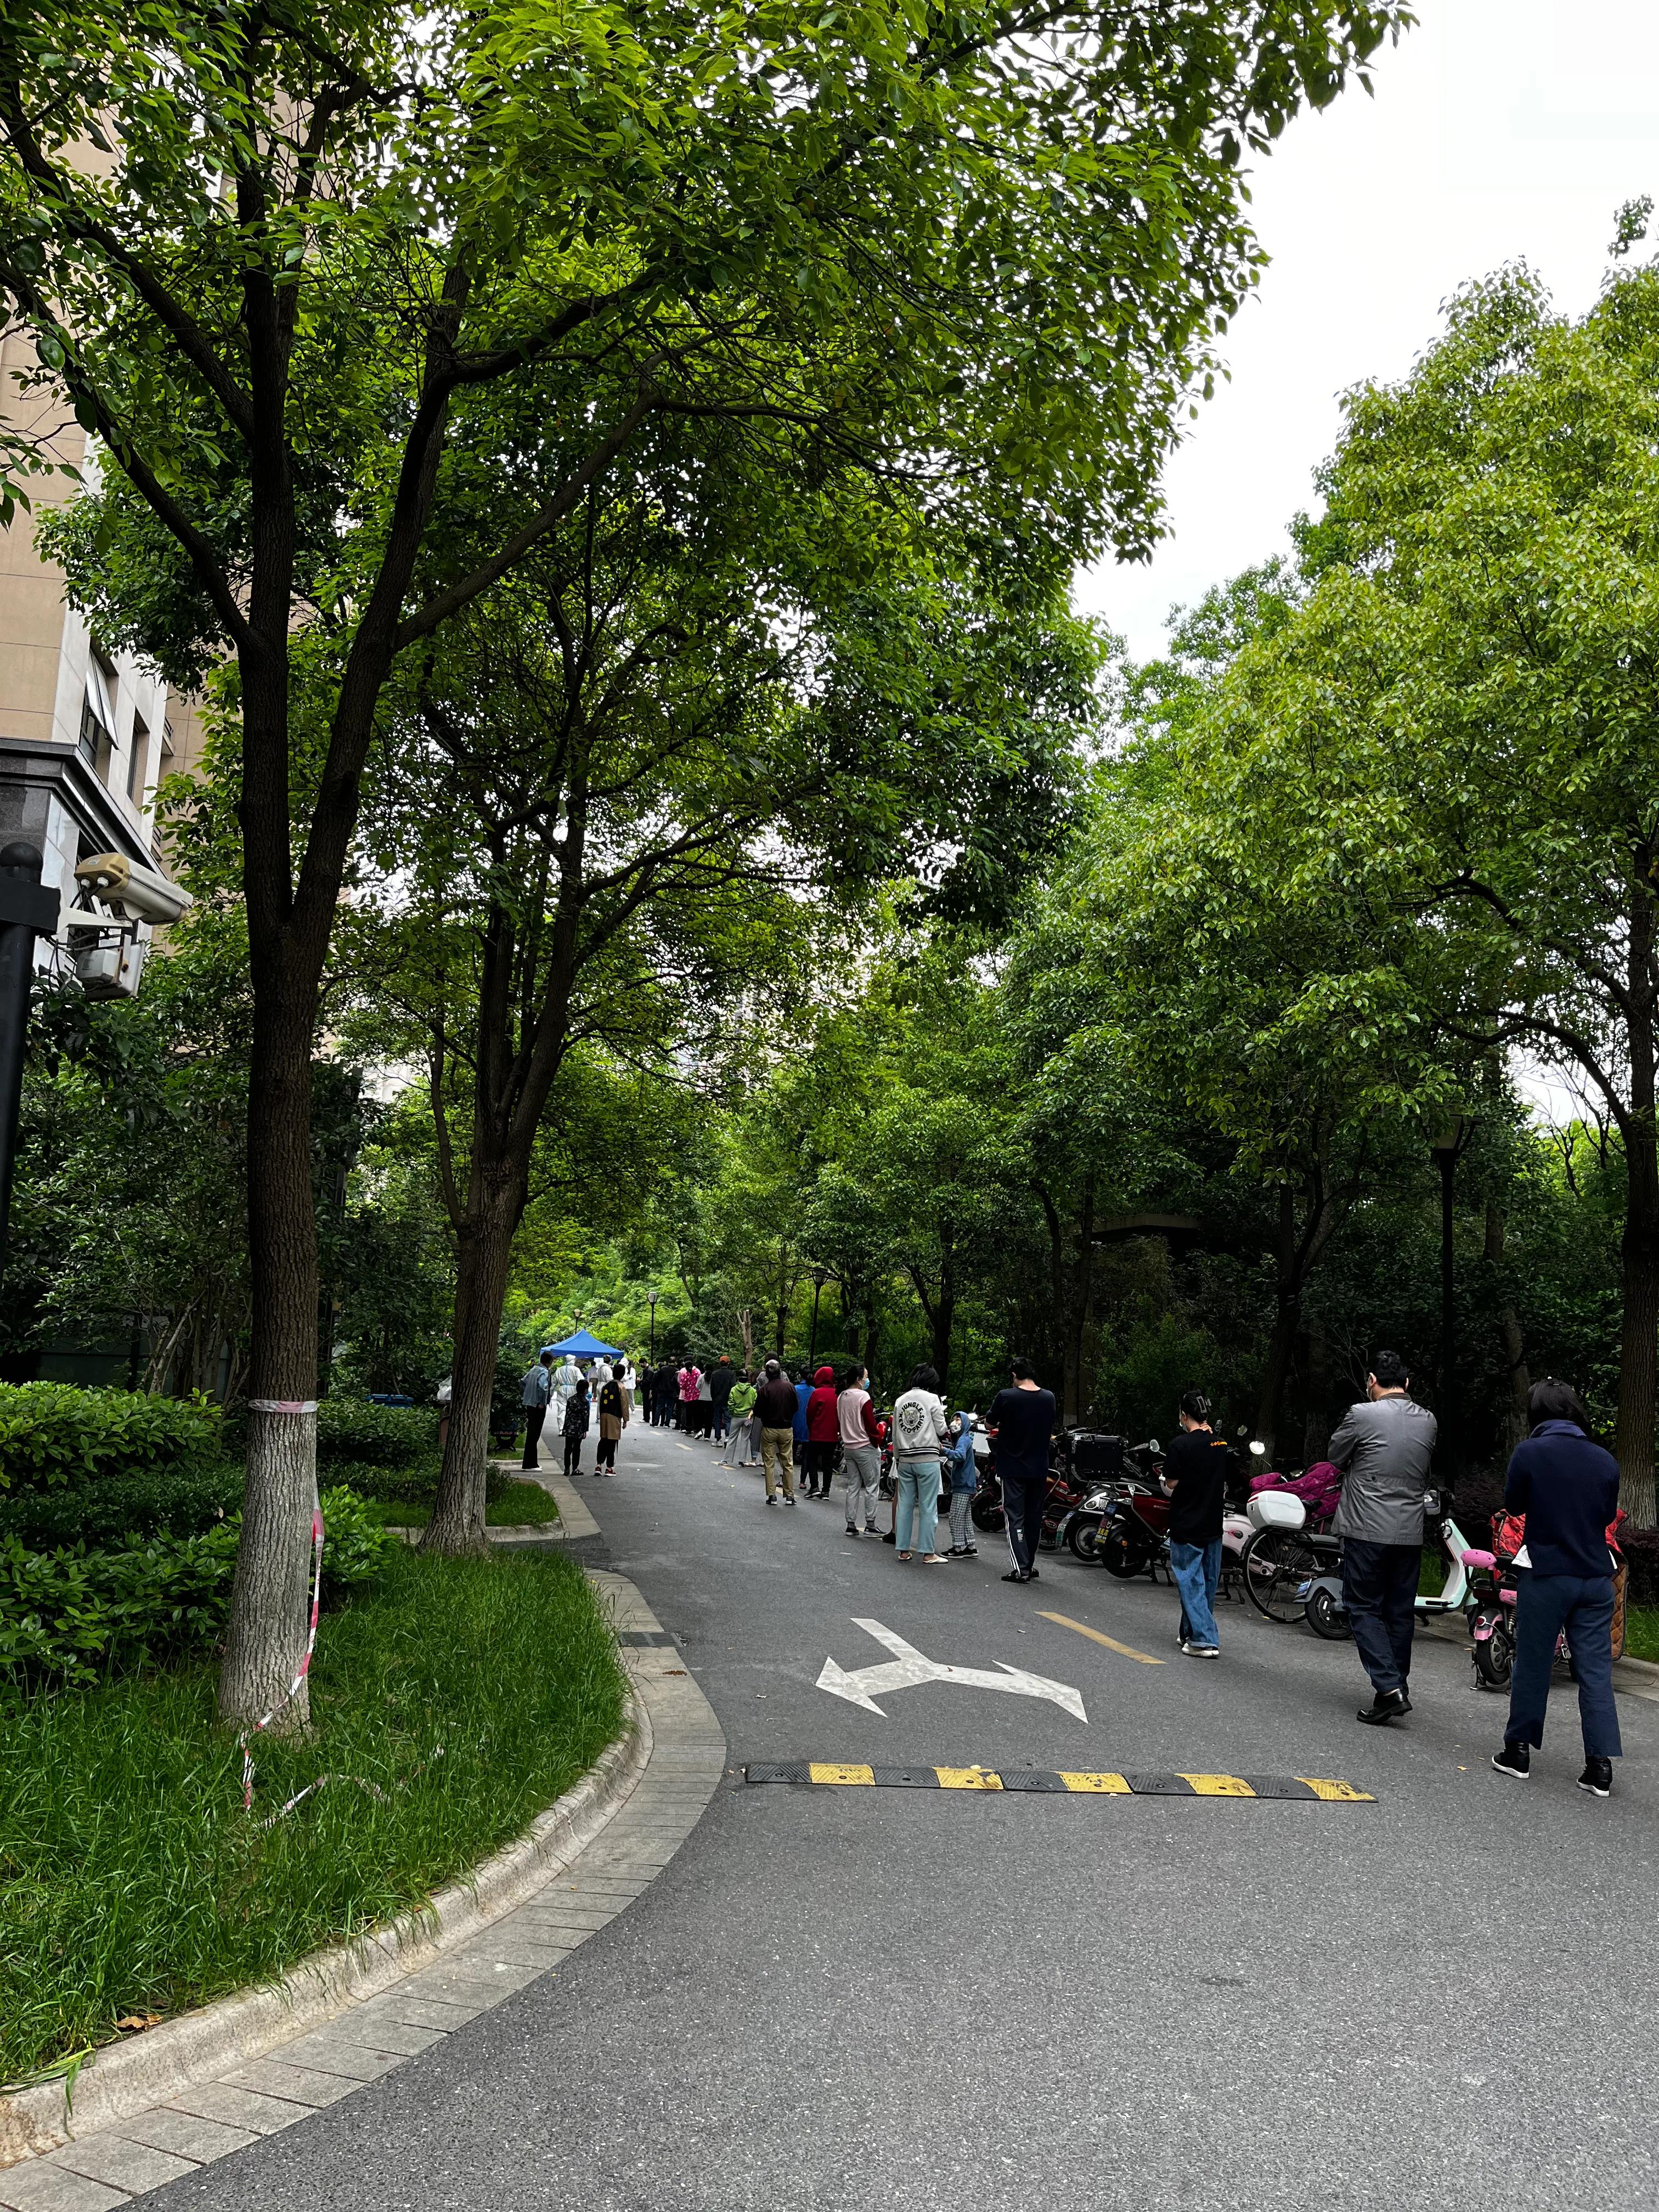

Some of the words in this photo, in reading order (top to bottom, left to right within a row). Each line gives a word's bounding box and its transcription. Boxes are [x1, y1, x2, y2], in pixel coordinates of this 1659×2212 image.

[901, 1402, 923, 1413] JUNGLE
[899, 1413, 911, 1434] KENZO
[911, 1415, 925, 1433] PARIS
